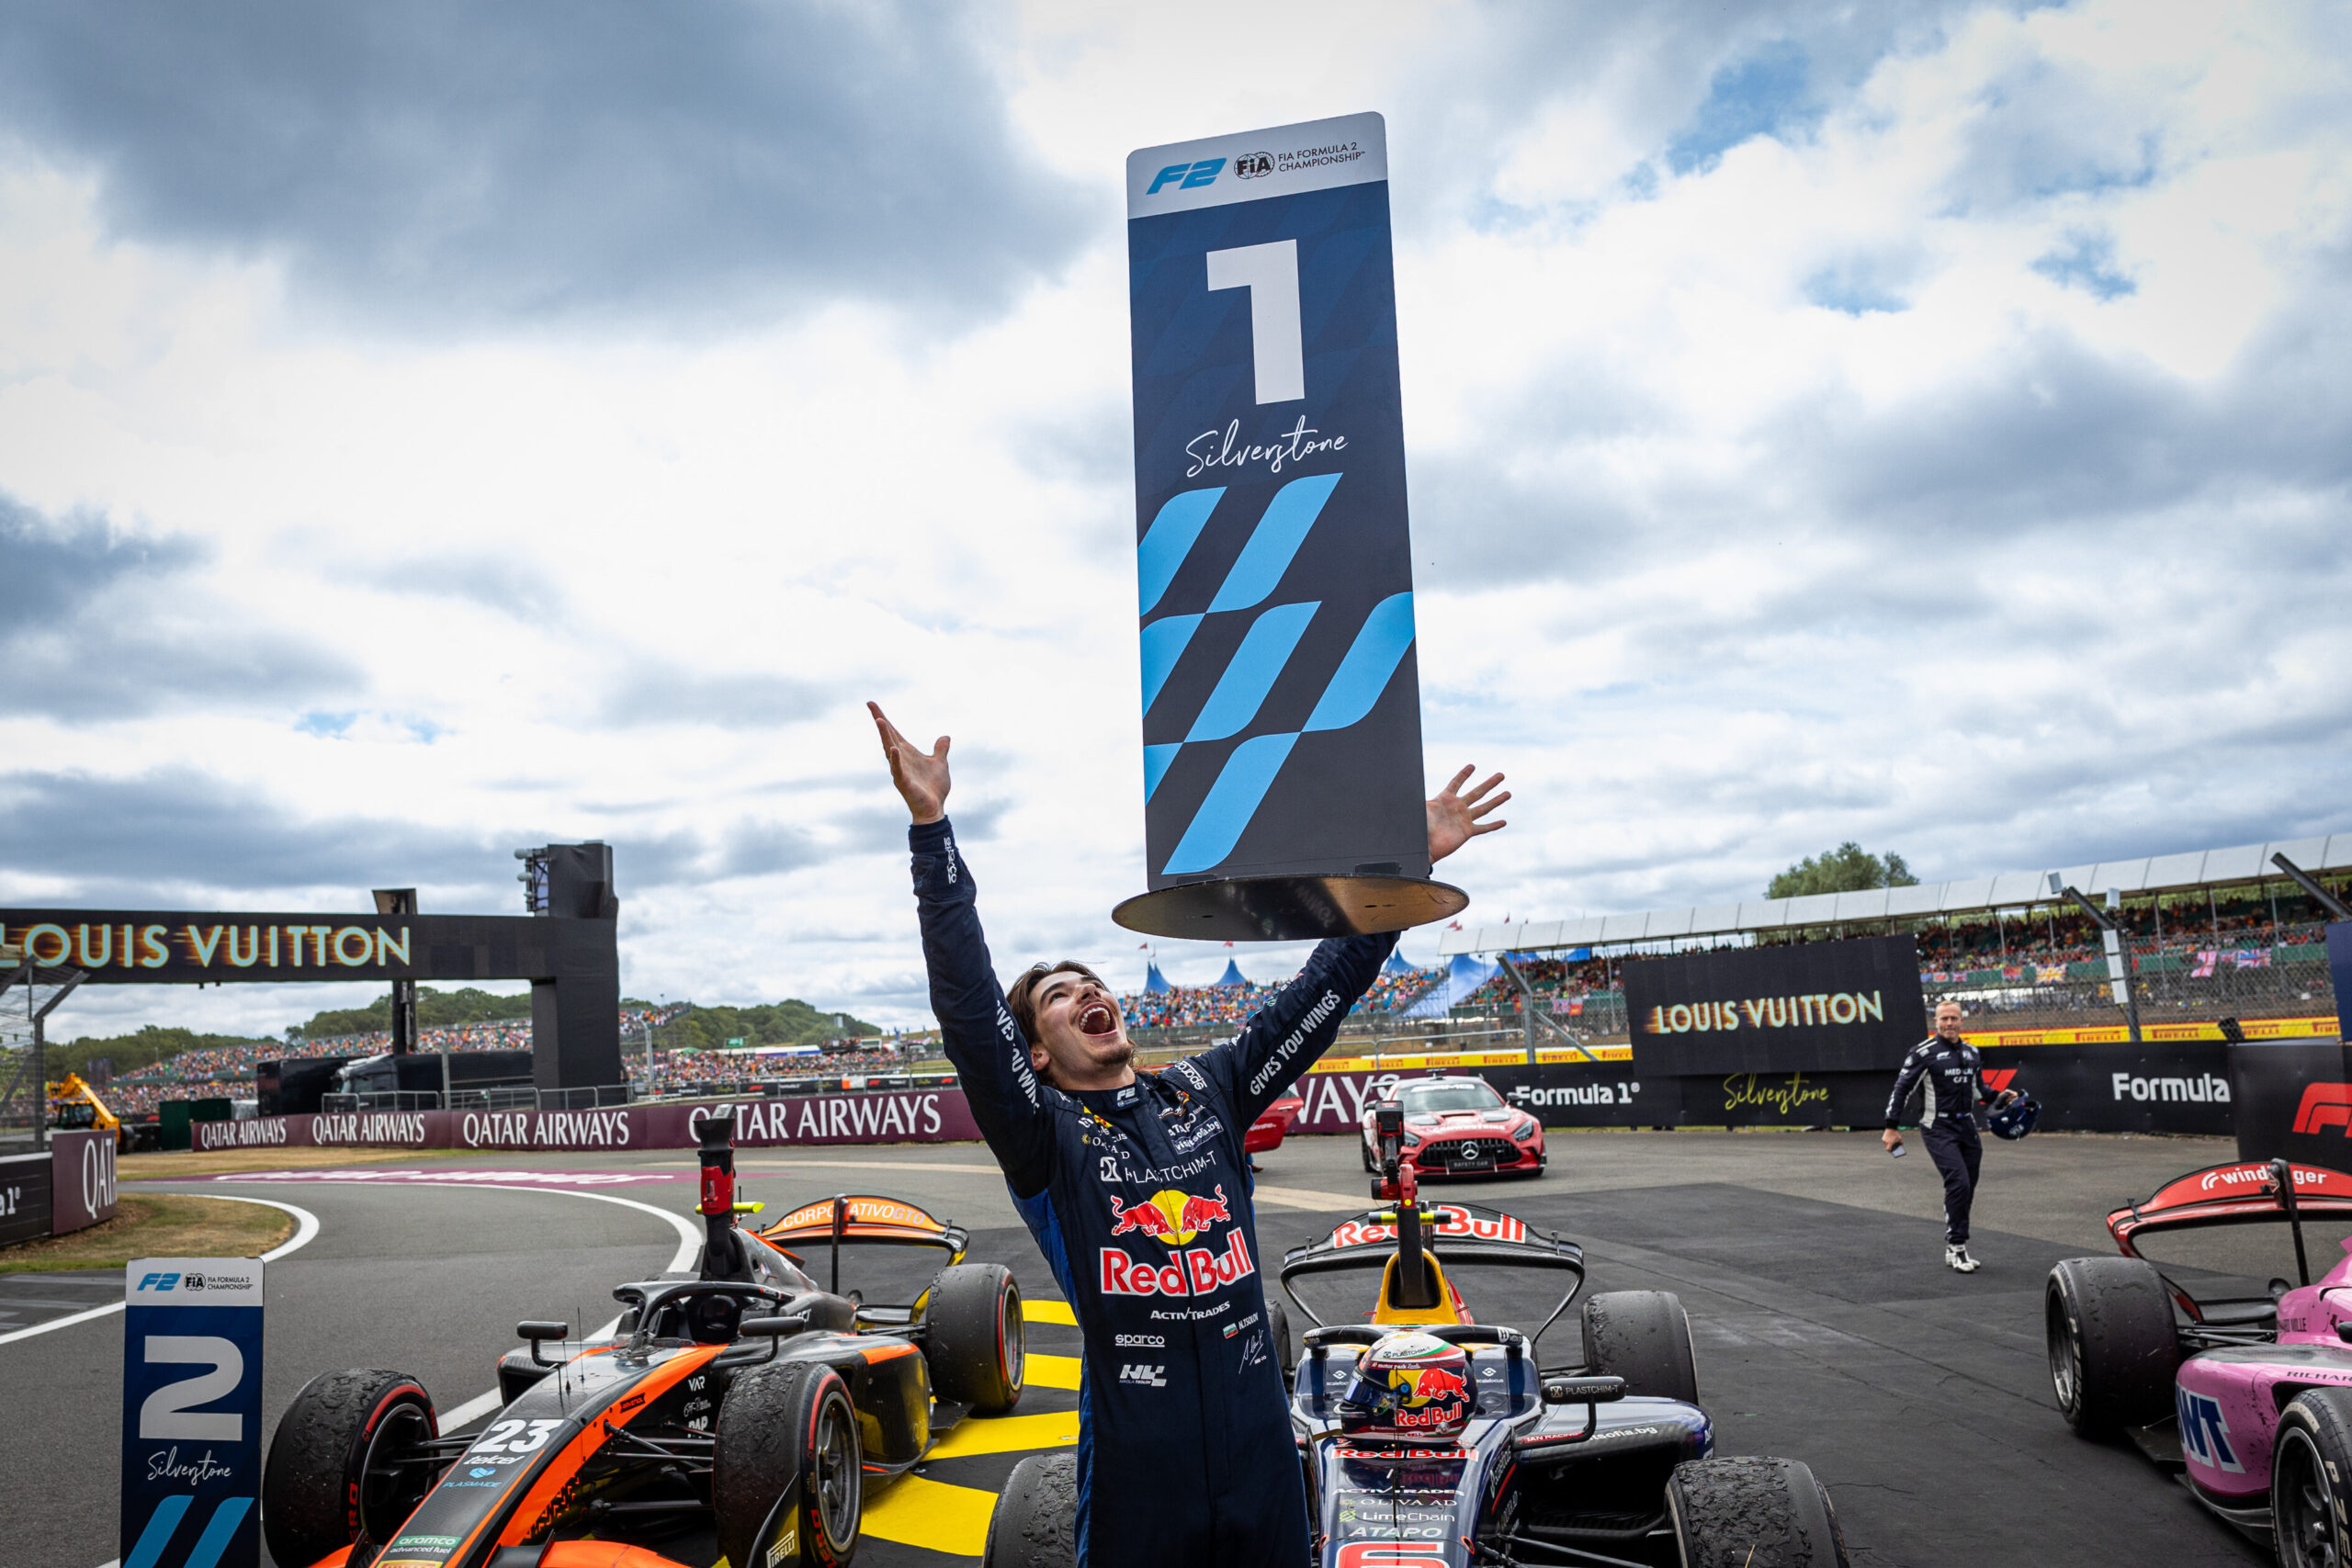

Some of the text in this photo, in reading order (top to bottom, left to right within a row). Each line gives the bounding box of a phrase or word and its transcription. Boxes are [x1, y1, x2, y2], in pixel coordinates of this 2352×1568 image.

[1278, 141, 1358, 163] FIA FORMULA 2
[1147, 157, 1227, 195] F2
[1205, 238, 1306, 405] 1
[1185, 414, 1350, 479] Silverstone
[188, 924, 411, 968] VUITTON
[1657, 989, 1883, 1034] LOUIS VUITTON
[1250, 1055, 1283, 1096] GIVES
[1276, 1029, 1305, 1061] YOU
[1300, 988, 1341, 1035] WINGS
[1116, 1087, 1136, 1101] F2
[1515, 1083, 1614, 1107] Formula
[1722, 1071, 1830, 1114] Silverstone
[2112, 1072, 2231, 1103] Formula
[201, 1117, 287, 1149] QATAR AIRWAYS
[312, 1112, 425, 1145] QATAR AIRWAYS
[463, 1111, 630, 1147] QATAR AIRWAYS
[797, 1094, 942, 1140] AIRWAYS
[1434, 1204, 1527, 1244] Bull
[1100, 1226, 1256, 1297] Red Bull
[137, 1272, 182, 1292] F2
[1114, 1333, 1166, 1348] sparco
[139, 1335, 244, 1441] 2
[1565, 1384, 1620, 1396] PLASTCHIM-T
[1395, 1401, 1463, 1427] Red Bull
[470, 1417, 565, 1453] 23
[147, 1445, 232, 1486] Silverstone
[463, 1454, 525, 1465] telcel
[1332, 1448, 1479, 1462] Red Bull
[1360, 1498, 1459, 1507] OLIVA AD
[1362, 1511, 1455, 1522] LimeChain
[399, 1536, 458, 1546] aramco
[1348, 1526, 1443, 1539] ATAPO
[390, 1545, 452, 1554] advanced fuel
